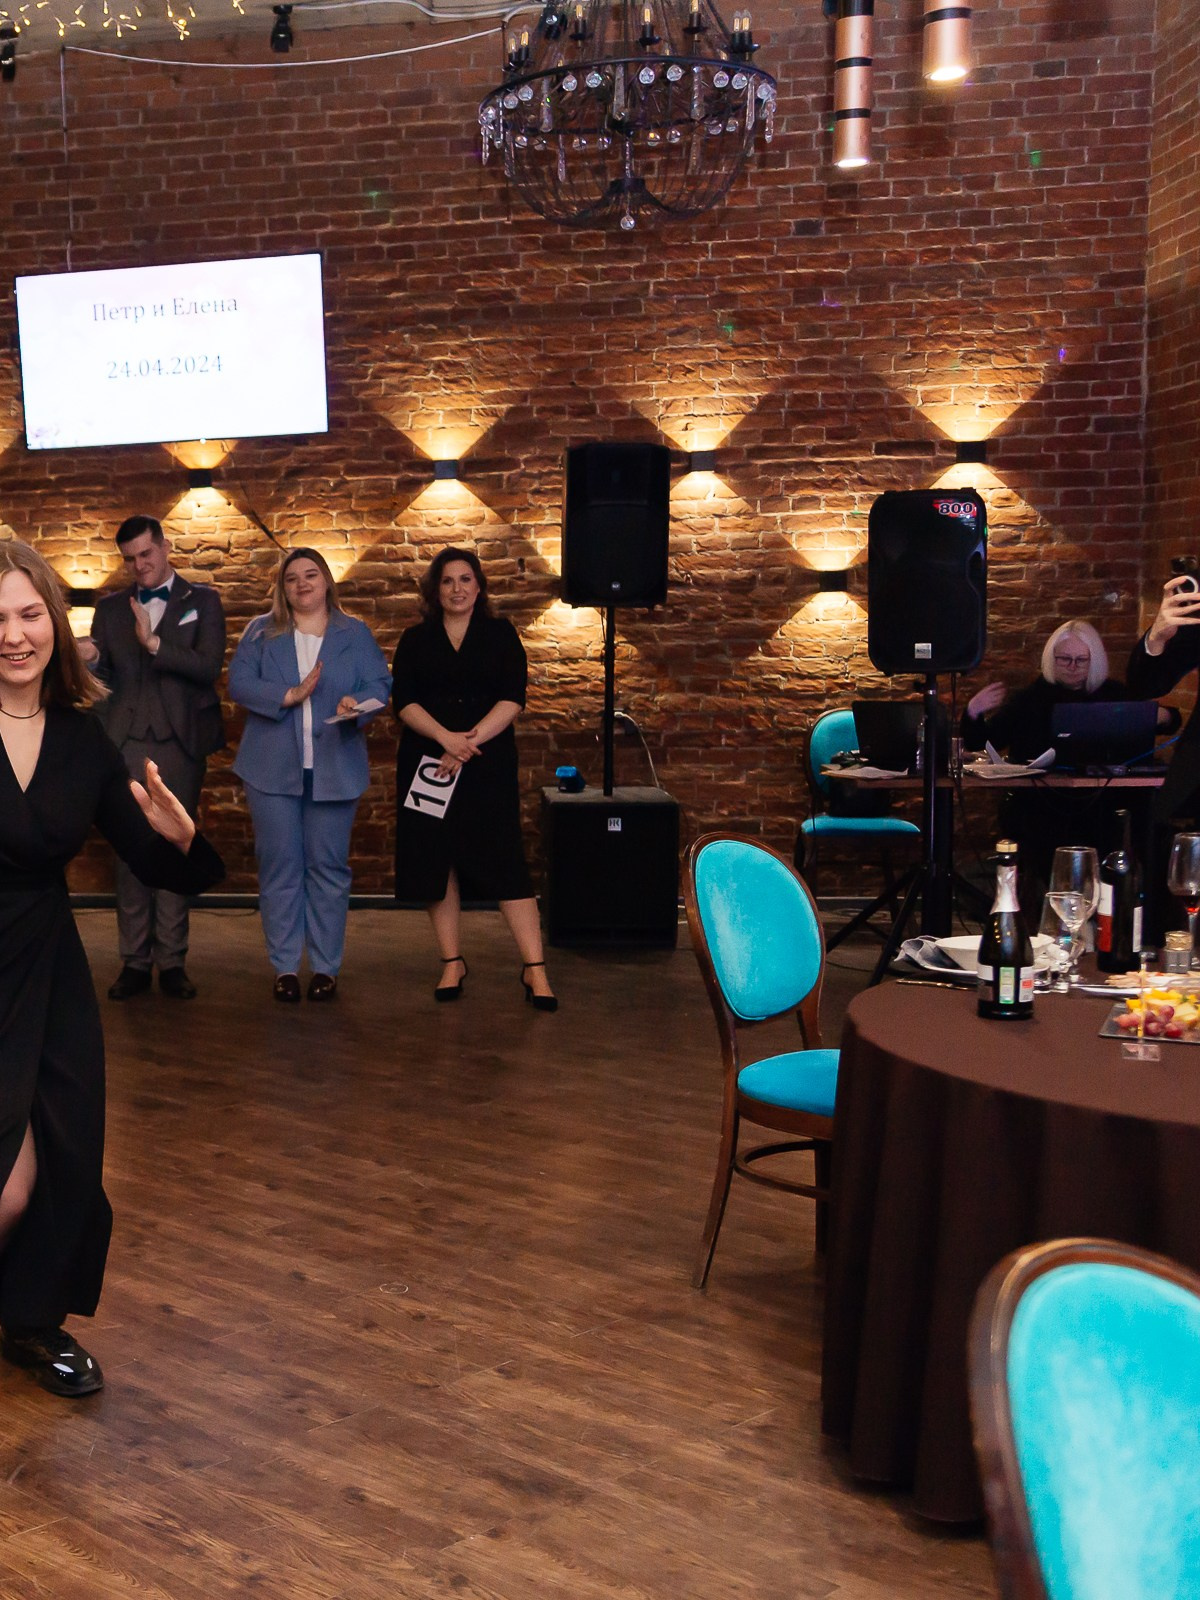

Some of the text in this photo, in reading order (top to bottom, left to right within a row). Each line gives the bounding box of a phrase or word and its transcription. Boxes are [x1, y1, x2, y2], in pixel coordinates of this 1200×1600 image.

[93, 297, 238, 323] Петр и Елена
[106, 355, 223, 379] 24.04.2024
[939, 502, 973, 515] 800
[409, 762, 457, 808] 10
